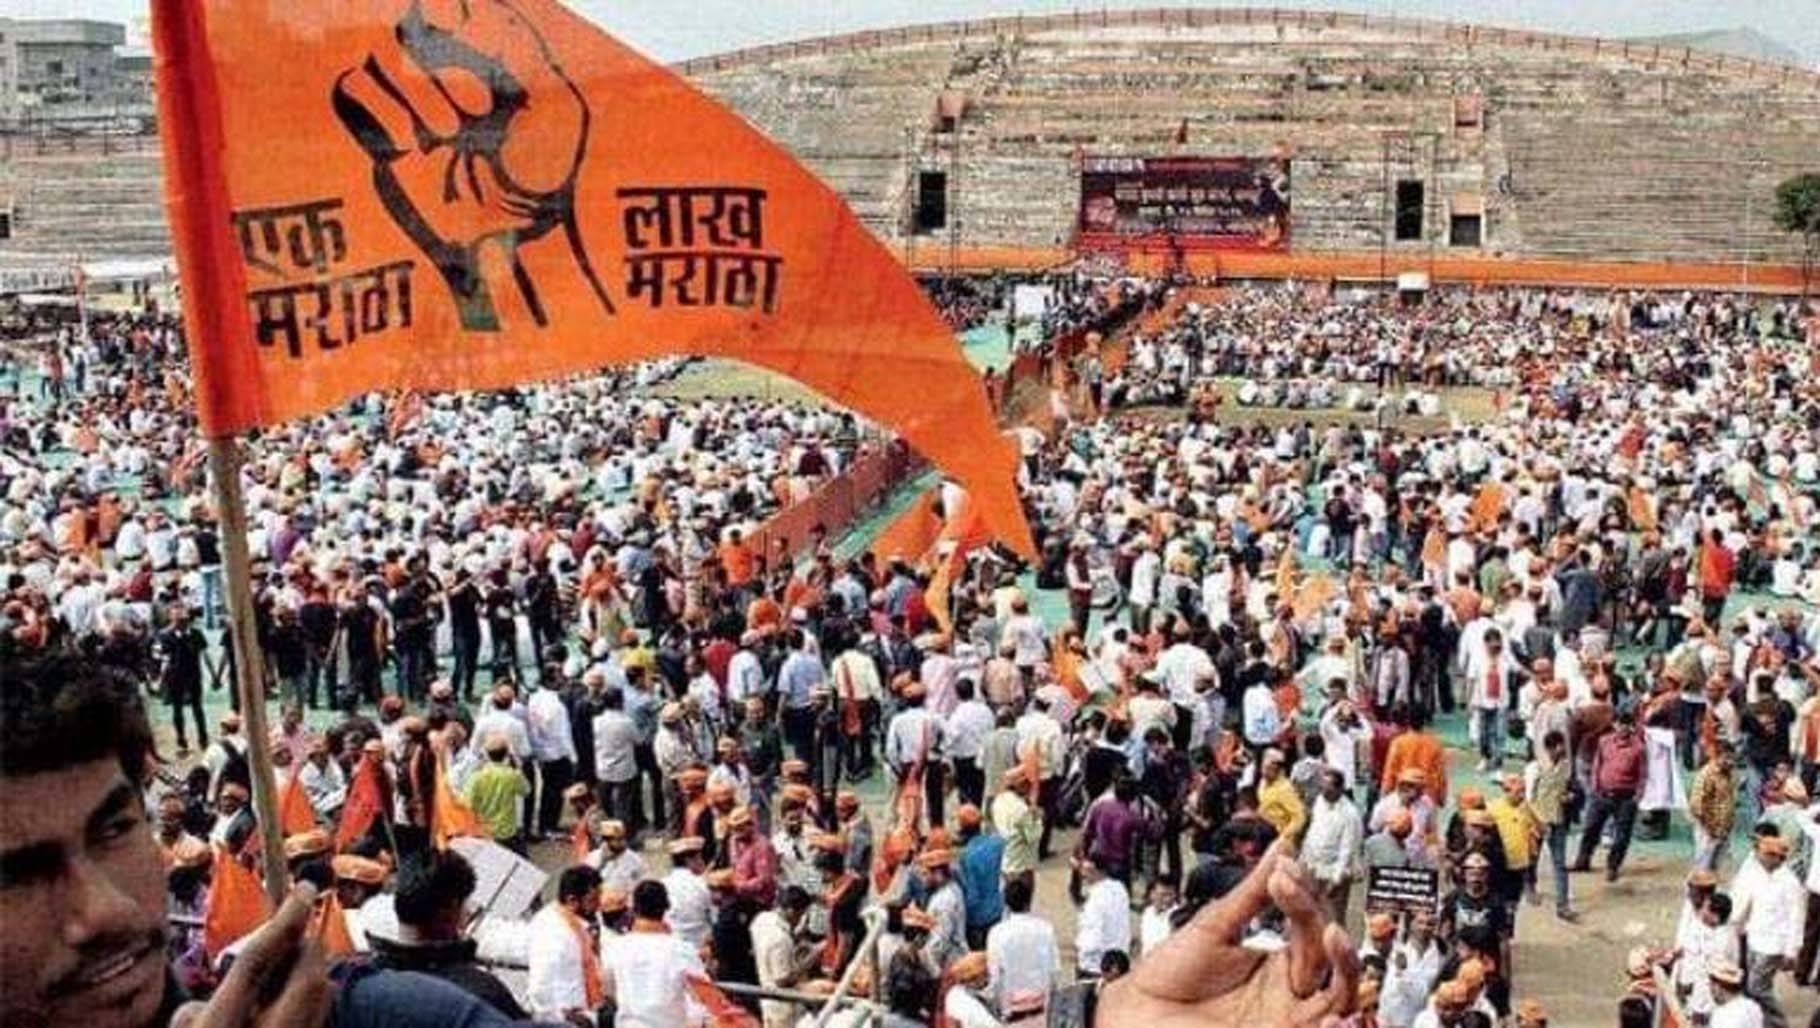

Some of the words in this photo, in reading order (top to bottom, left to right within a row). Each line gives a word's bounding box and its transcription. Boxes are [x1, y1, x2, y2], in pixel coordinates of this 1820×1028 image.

[231, 198, 346, 275] एक
[617, 187, 767, 250] लाख
[248, 260, 415, 358] मराठा
[624, 251, 784, 314] मराठा
